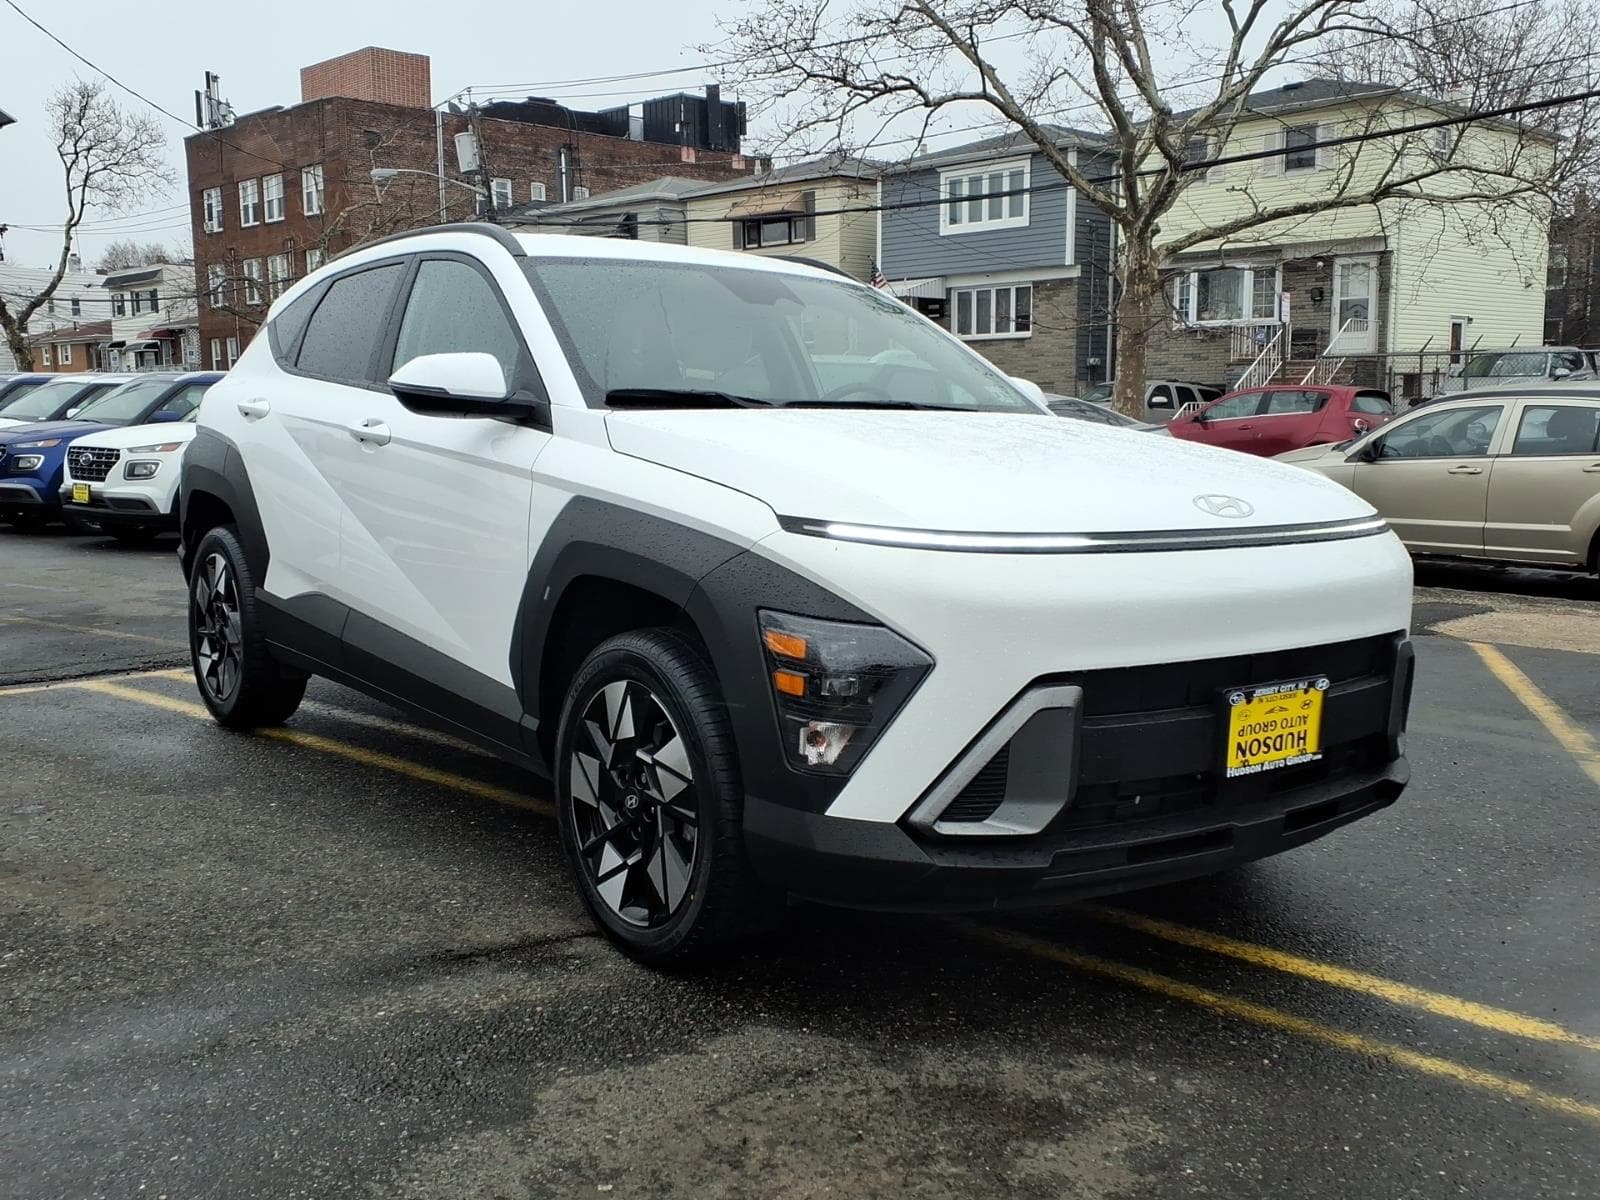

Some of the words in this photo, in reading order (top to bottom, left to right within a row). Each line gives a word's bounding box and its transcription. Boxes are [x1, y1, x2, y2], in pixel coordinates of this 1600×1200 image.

[1238, 719, 1278, 737] GROUP
[1280, 714, 1310, 730] AUTO
[1236, 730, 1307, 759] HUDSON
